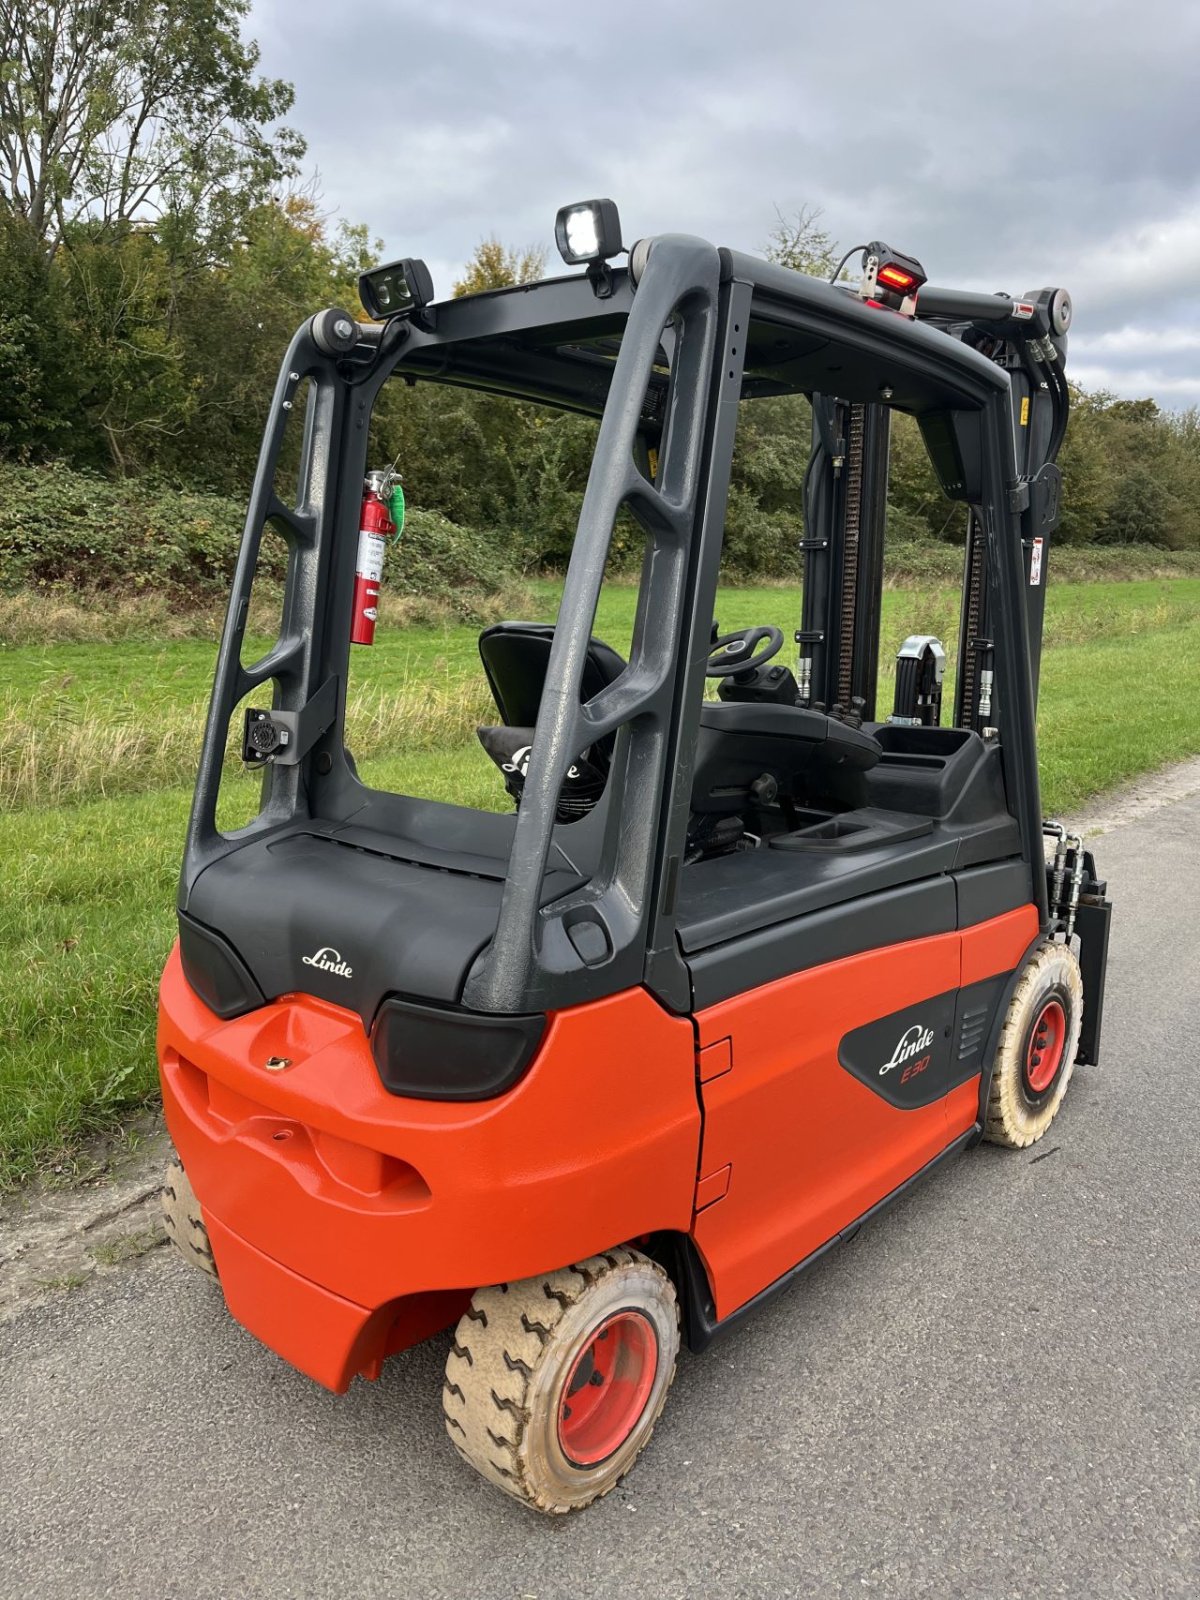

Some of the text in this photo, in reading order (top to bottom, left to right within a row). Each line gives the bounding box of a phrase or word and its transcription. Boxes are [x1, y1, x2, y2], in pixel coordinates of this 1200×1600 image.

[502, 745, 580, 778] Lie
[302, 947, 353, 978] Linde
[878, 1024, 934, 1075] Linde
